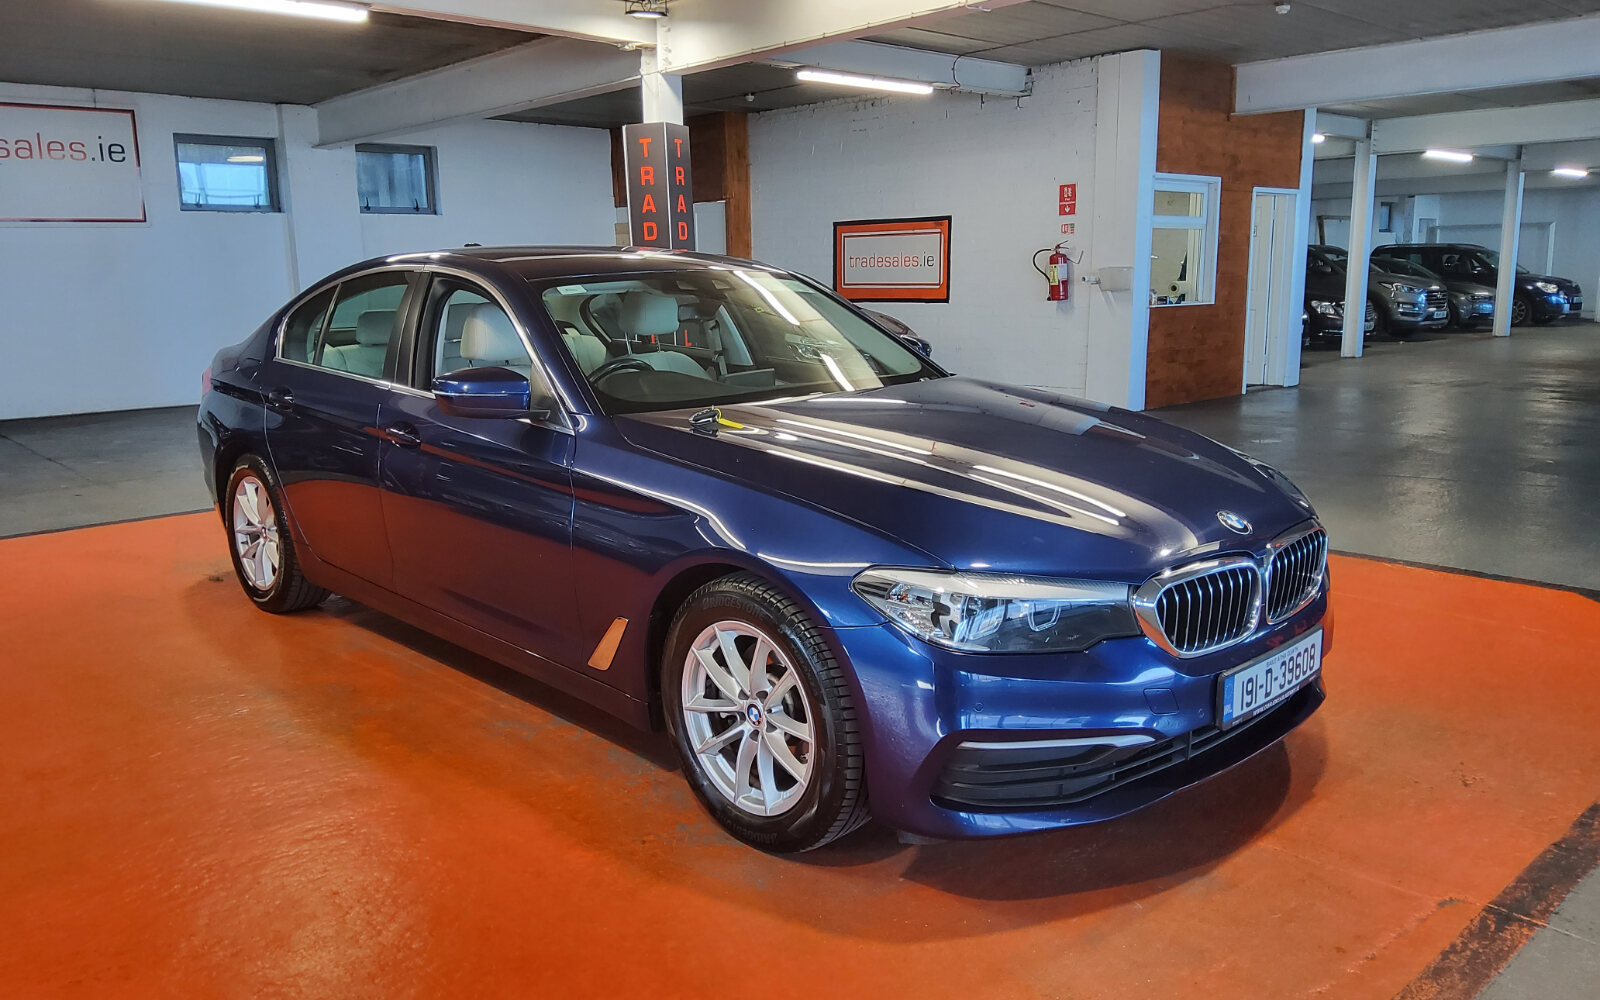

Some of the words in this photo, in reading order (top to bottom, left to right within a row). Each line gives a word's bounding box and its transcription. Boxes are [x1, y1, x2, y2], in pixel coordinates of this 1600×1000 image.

[638, 137, 658, 241] TRAD
[674, 138, 688, 243] TRAD
[849, 251, 934, 268] tradesales.ie
[1241, 643, 1316, 711] 191-D-39608
